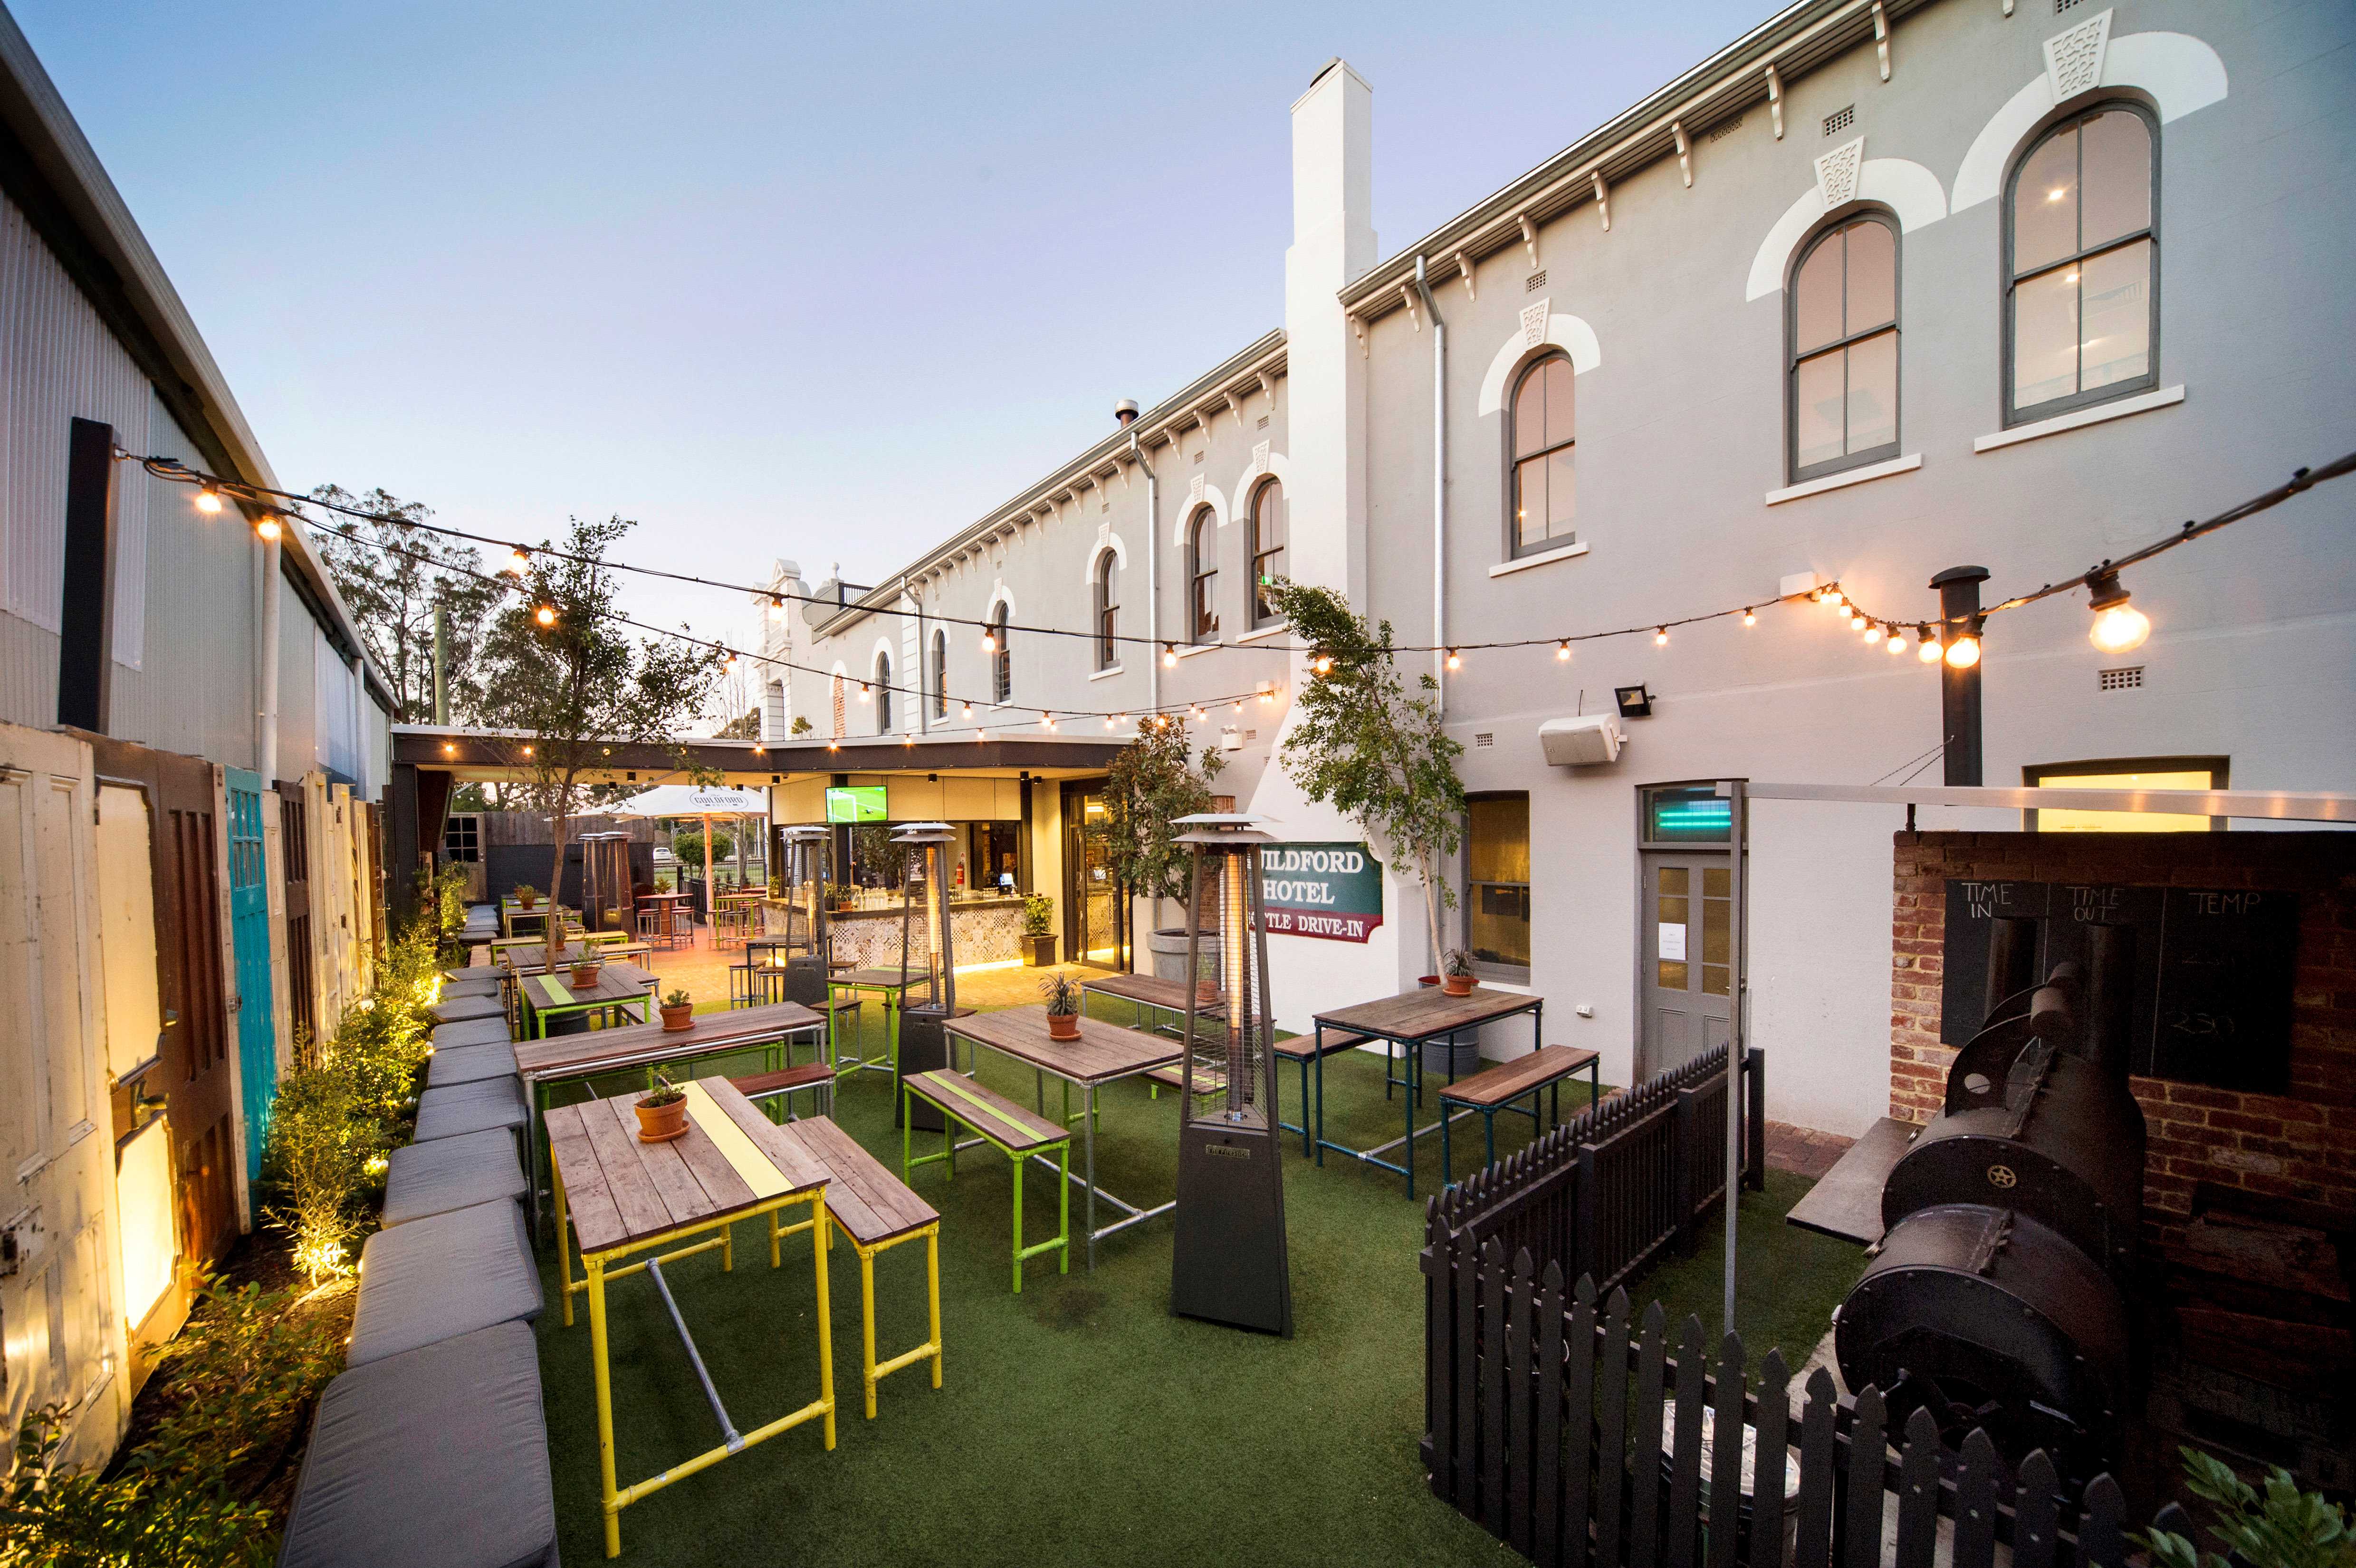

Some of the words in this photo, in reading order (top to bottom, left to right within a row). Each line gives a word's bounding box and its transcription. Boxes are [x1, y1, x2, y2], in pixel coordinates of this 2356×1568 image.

[1260, 850, 1364, 873] ILDFORD
[1263, 879, 1335, 904] HOTEL
[1961, 883, 2013, 905] TIME
[2065, 886, 2126, 906] TIME
[1972, 901, 1992, 918] IN
[2074, 906, 2117, 922] OUT
[2188, 892, 2261, 916] TEMP
[1298, 915, 1364, 938] DRIVE-IN
